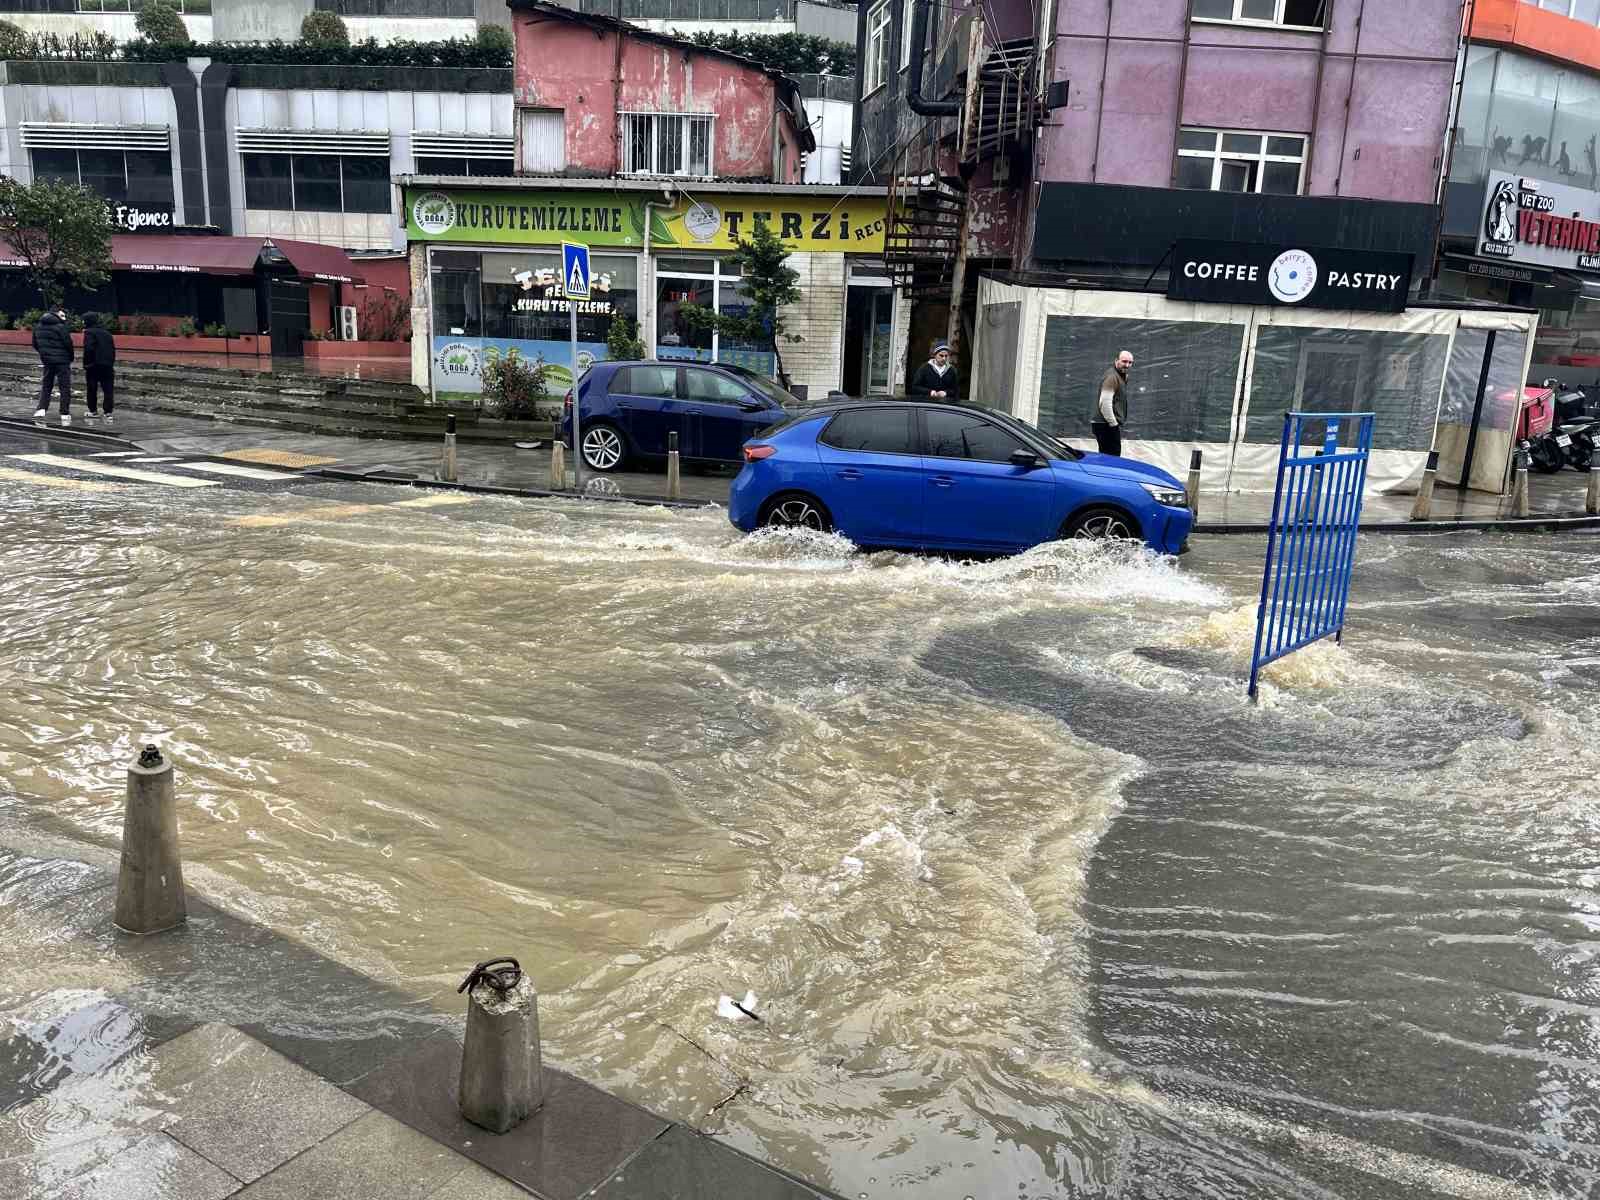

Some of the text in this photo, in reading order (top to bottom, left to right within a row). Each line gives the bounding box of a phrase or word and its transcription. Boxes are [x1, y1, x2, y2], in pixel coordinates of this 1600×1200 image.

[1521, 192, 1554, 210] VET ZOO
[116, 206, 170, 231] Eğlence
[456, 201, 622, 233] KURUTEMİZLEME
[1183, 261, 1401, 291] COFFEE PASTRY
